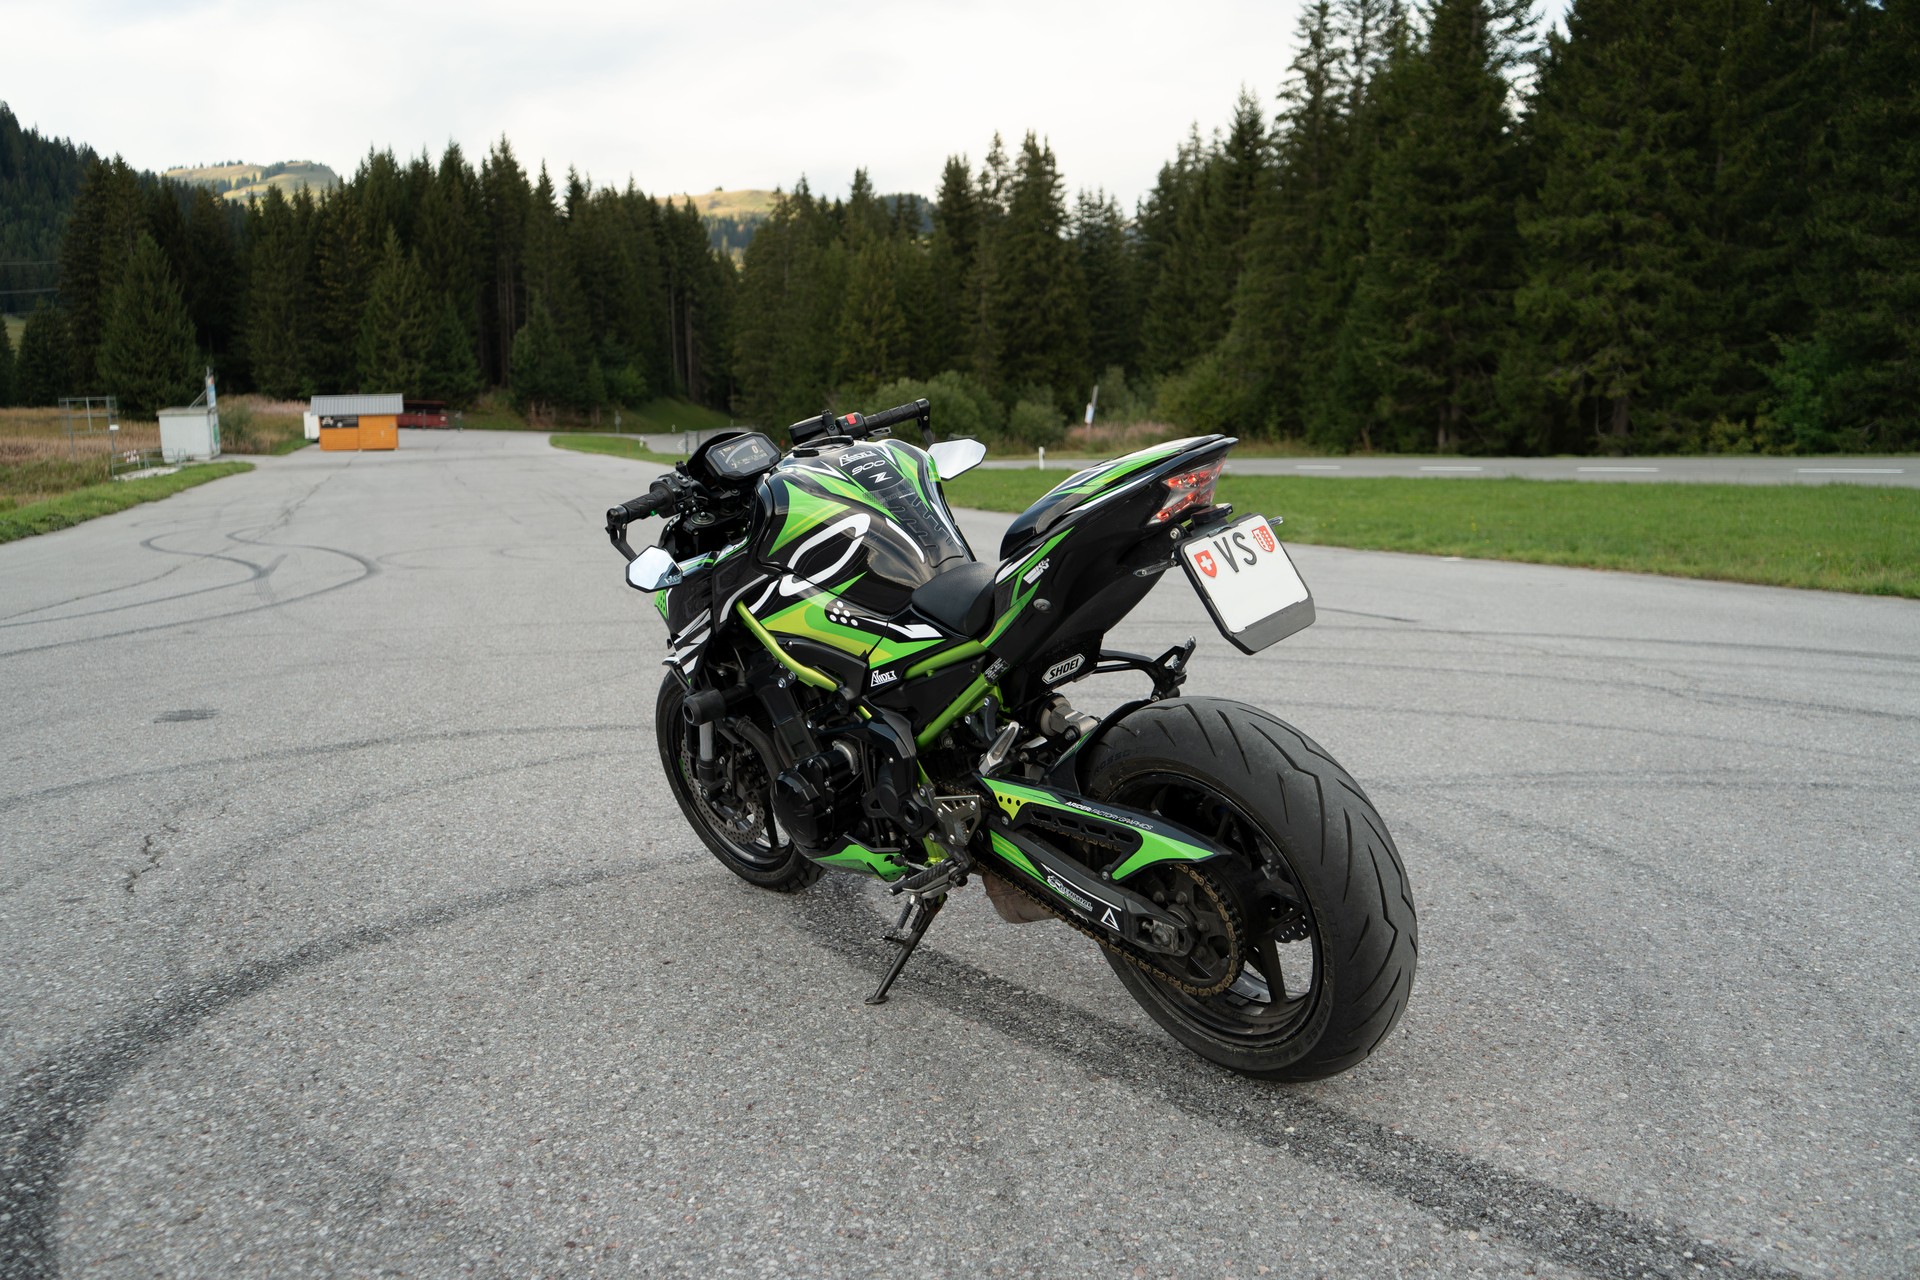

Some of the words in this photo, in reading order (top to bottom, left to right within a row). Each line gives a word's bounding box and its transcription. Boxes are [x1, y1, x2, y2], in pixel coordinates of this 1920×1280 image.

[851, 459, 886, 476] 900
[1213, 531, 1258, 573] VS
[1048, 658, 1080, 680] SHOEI
[1091, 808, 1119, 821] FACTORY
[1118, 815, 1154, 831] GRAPHICS
